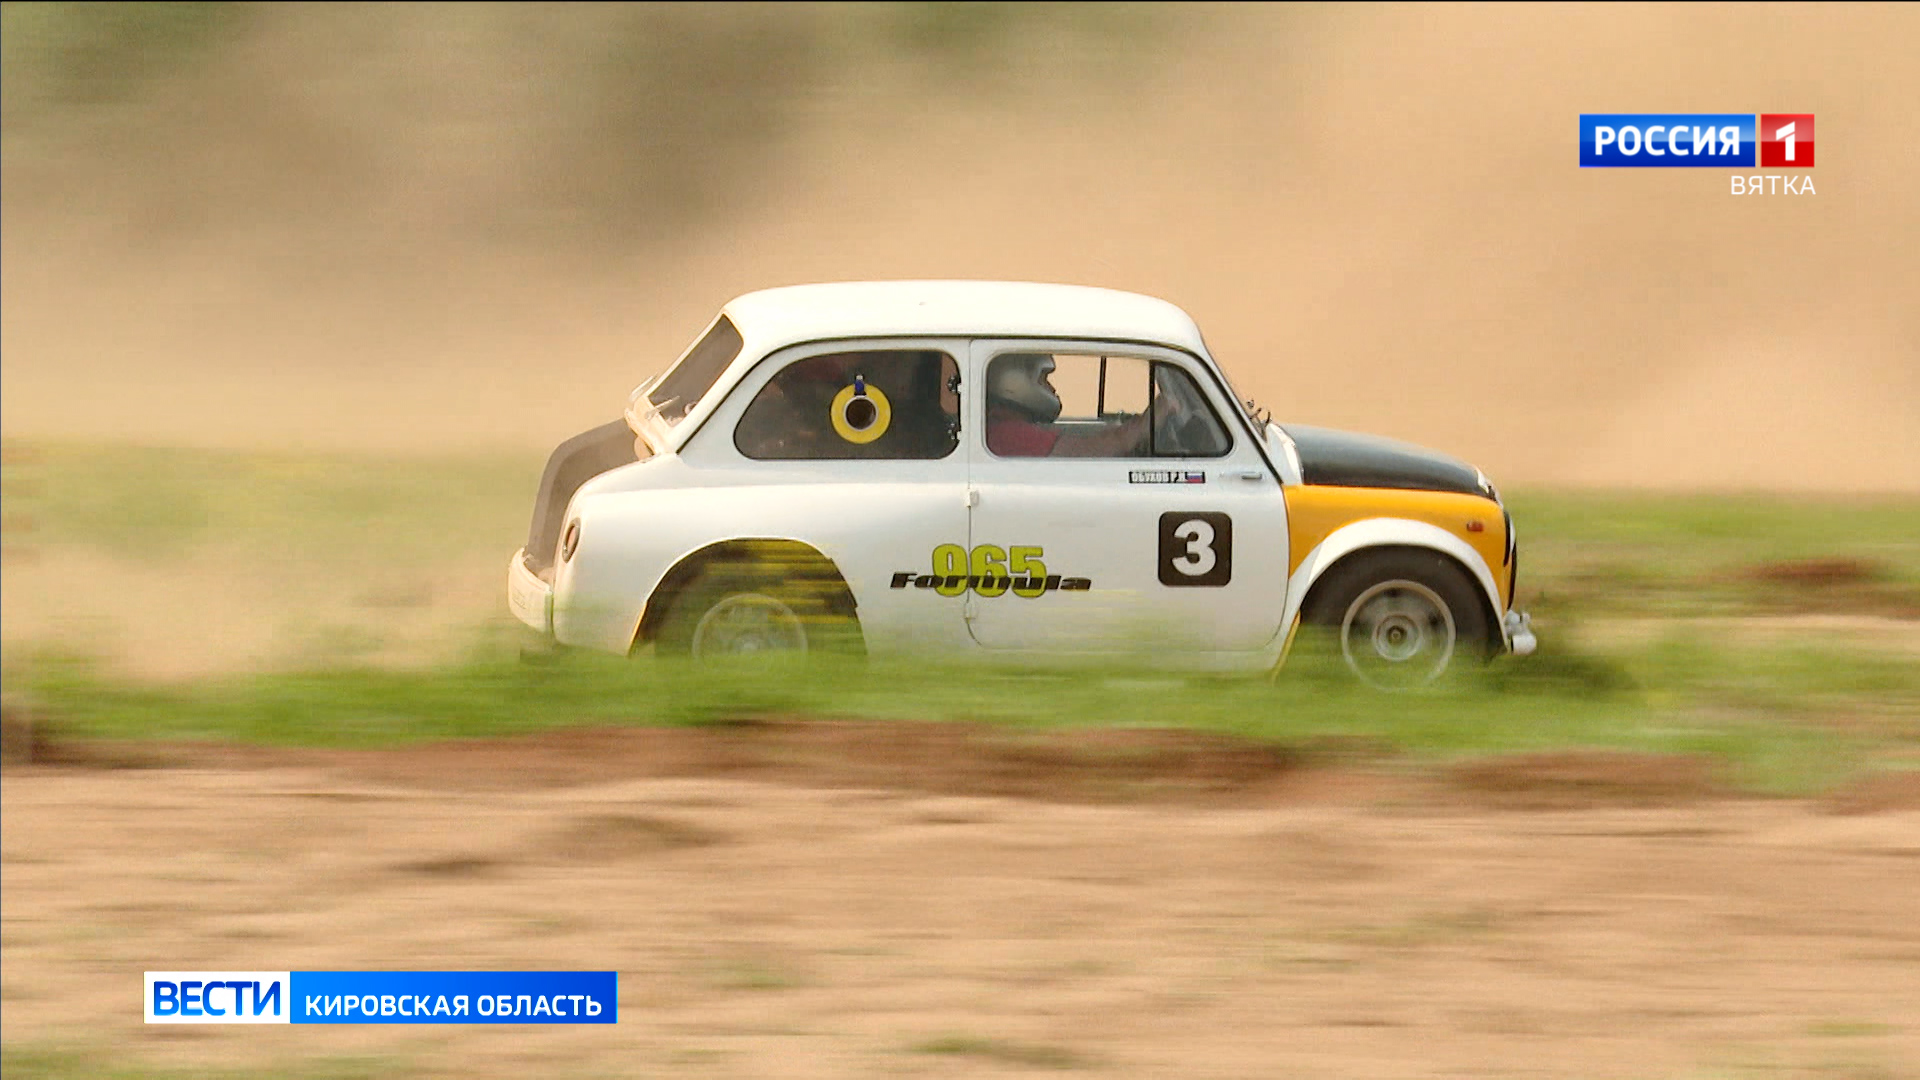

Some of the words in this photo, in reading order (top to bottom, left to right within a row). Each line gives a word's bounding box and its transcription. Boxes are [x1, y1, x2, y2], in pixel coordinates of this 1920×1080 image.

[932, 543, 1047, 598] 965
[1171, 519, 1216, 576] 3
[890, 571, 1091, 590] Formula
